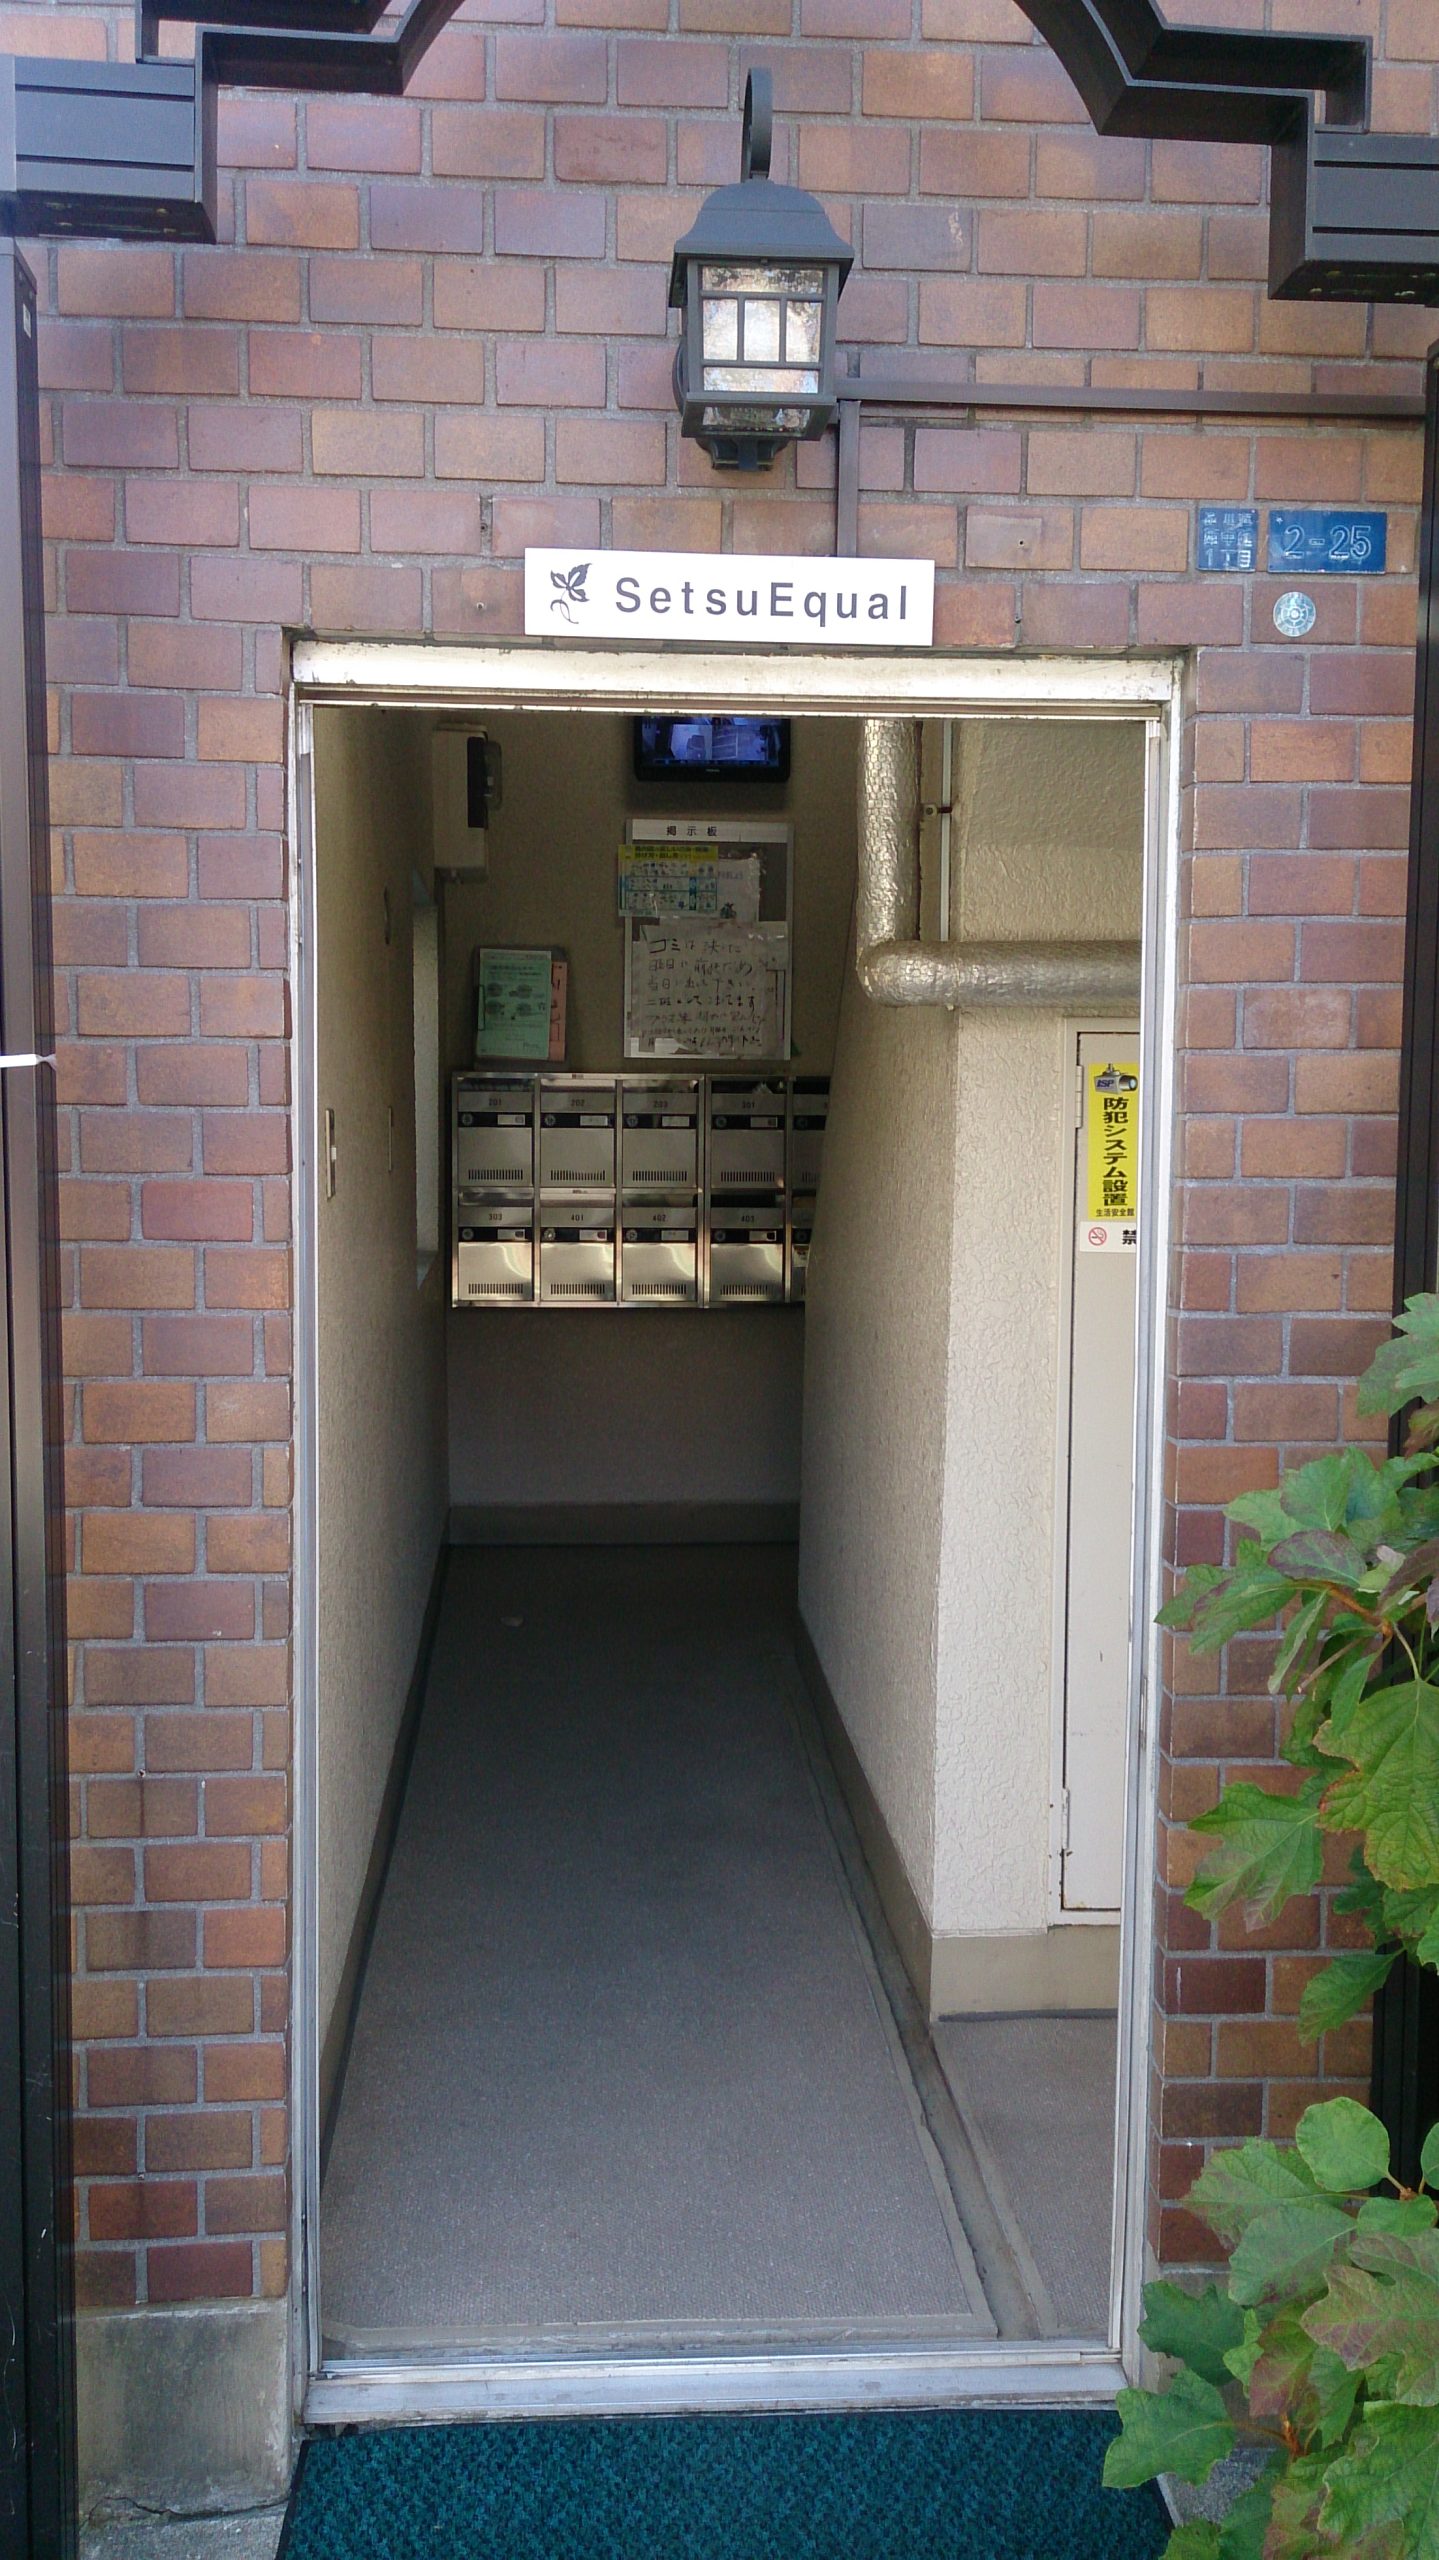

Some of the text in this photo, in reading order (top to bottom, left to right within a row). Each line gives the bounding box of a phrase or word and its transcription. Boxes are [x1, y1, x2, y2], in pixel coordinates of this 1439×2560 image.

[615, 576, 908, 628] SetsuEqual
[666, 825, 717, 837] 掲示板
[1096, 1079, 1115, 1088] ISP
[1103, 1097, 1129, 1206] 防犯システム設置
[571, 1214, 584, 1222] 401
[652, 1214, 666, 1222] 402
